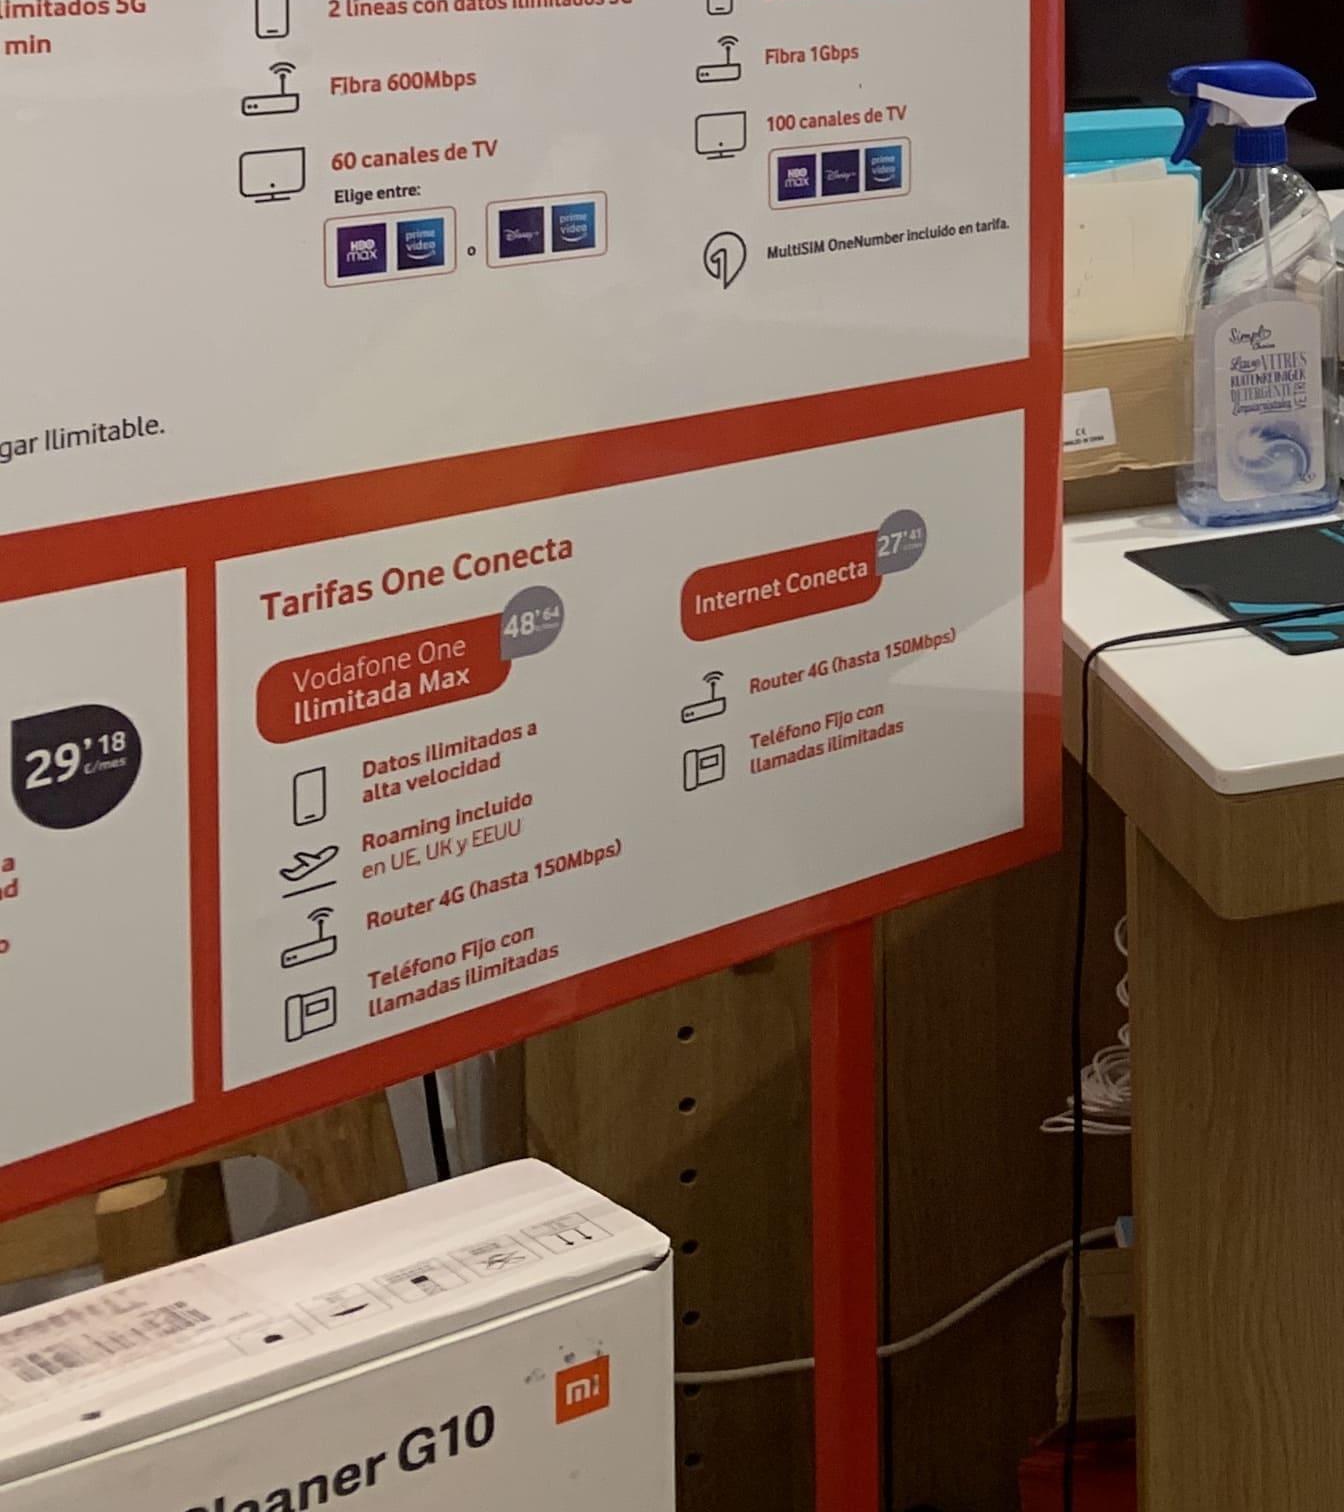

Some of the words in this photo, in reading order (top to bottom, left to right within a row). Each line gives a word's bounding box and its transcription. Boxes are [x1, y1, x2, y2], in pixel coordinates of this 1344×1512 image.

[328, 0, 341, 17] 2
[5, 34, 51, 55] min
[765, 47, 806, 65] Fibra
[810, 44, 860, 65] 1Gbps
[330, 75, 381, 95] Fibra
[387, 70, 477, 93] 600Mbps
[766, 114, 796, 133] 100
[799, 108, 861, 129] canales
[864, 107, 883, 124] de
[886, 105, 907, 121] TV
[331, 151, 356, 171] 60
[362, 143, 439, 168] canales
[444, 142, 468, 162] de
[472, 139, 499, 158] TV
[333, 188, 374, 207] Elige
[376, 184, 422, 200] entre:
[767, 240, 826, 260] MultiSIM
[828, 230, 905, 253] OneNumber
[906, 222, 956, 242] incluido
[958, 223, 974, 235] en
[975, 216, 1011, 233] tarifa.
[45, 416, 166, 451] Ilimitable.
[259, 576, 374, 620] Tarifas
[381, 564, 445, 597] One
[452, 538, 574, 582] Conecta
[694, 578, 782, 616] Internet
[785, 559, 869, 595] Conecta
[292, 648, 412, 693] Vodafone
[417, 637, 467, 664] One
[750, 669, 804, 695] Router
[808, 660, 829, 680] 4G
[832, 649, 881, 674] (hasta
[884, 627, 957, 658] 150Mbps)
[293, 681, 412, 726] Ilimitada
[419, 666, 471, 696] Max
[362, 751, 421, 780] Datos
[425, 724, 523, 761] ilimitados
[526, 721, 538, 738] a
[750, 719, 822, 750] Teléfono
[825, 710, 853, 731] Fijo
[856, 702, 885, 721] con
[750, 744, 825, 775] llamadas
[827, 720, 905, 753] ilimitadas
[362, 779, 402, 804] alta
[405, 751, 502, 792] velocidad
[362, 815, 451, 853] Roaming
[455, 791, 534, 827] incluido
[362, 860, 386, 880] en
[390, 847, 422, 873] UE,
[426, 838, 453, 861] UK
[455, 836, 469, 857] y
[471, 818, 522, 849] EEUU
[366, 894, 435, 931] Router
[439, 885, 466, 908] 4G
[469, 868, 530, 901] (hasta
[534, 838, 622, 880] 150Mbps)
[368, 949, 457, 990] Teléfono
[461, 936, 497, 962] Fijo
[500, 925, 535, 948] con
[368, 973, 461, 1017] llamadas
[465, 942, 560, 988] ilimitadas
[397, 1404, 495, 1472] G10
